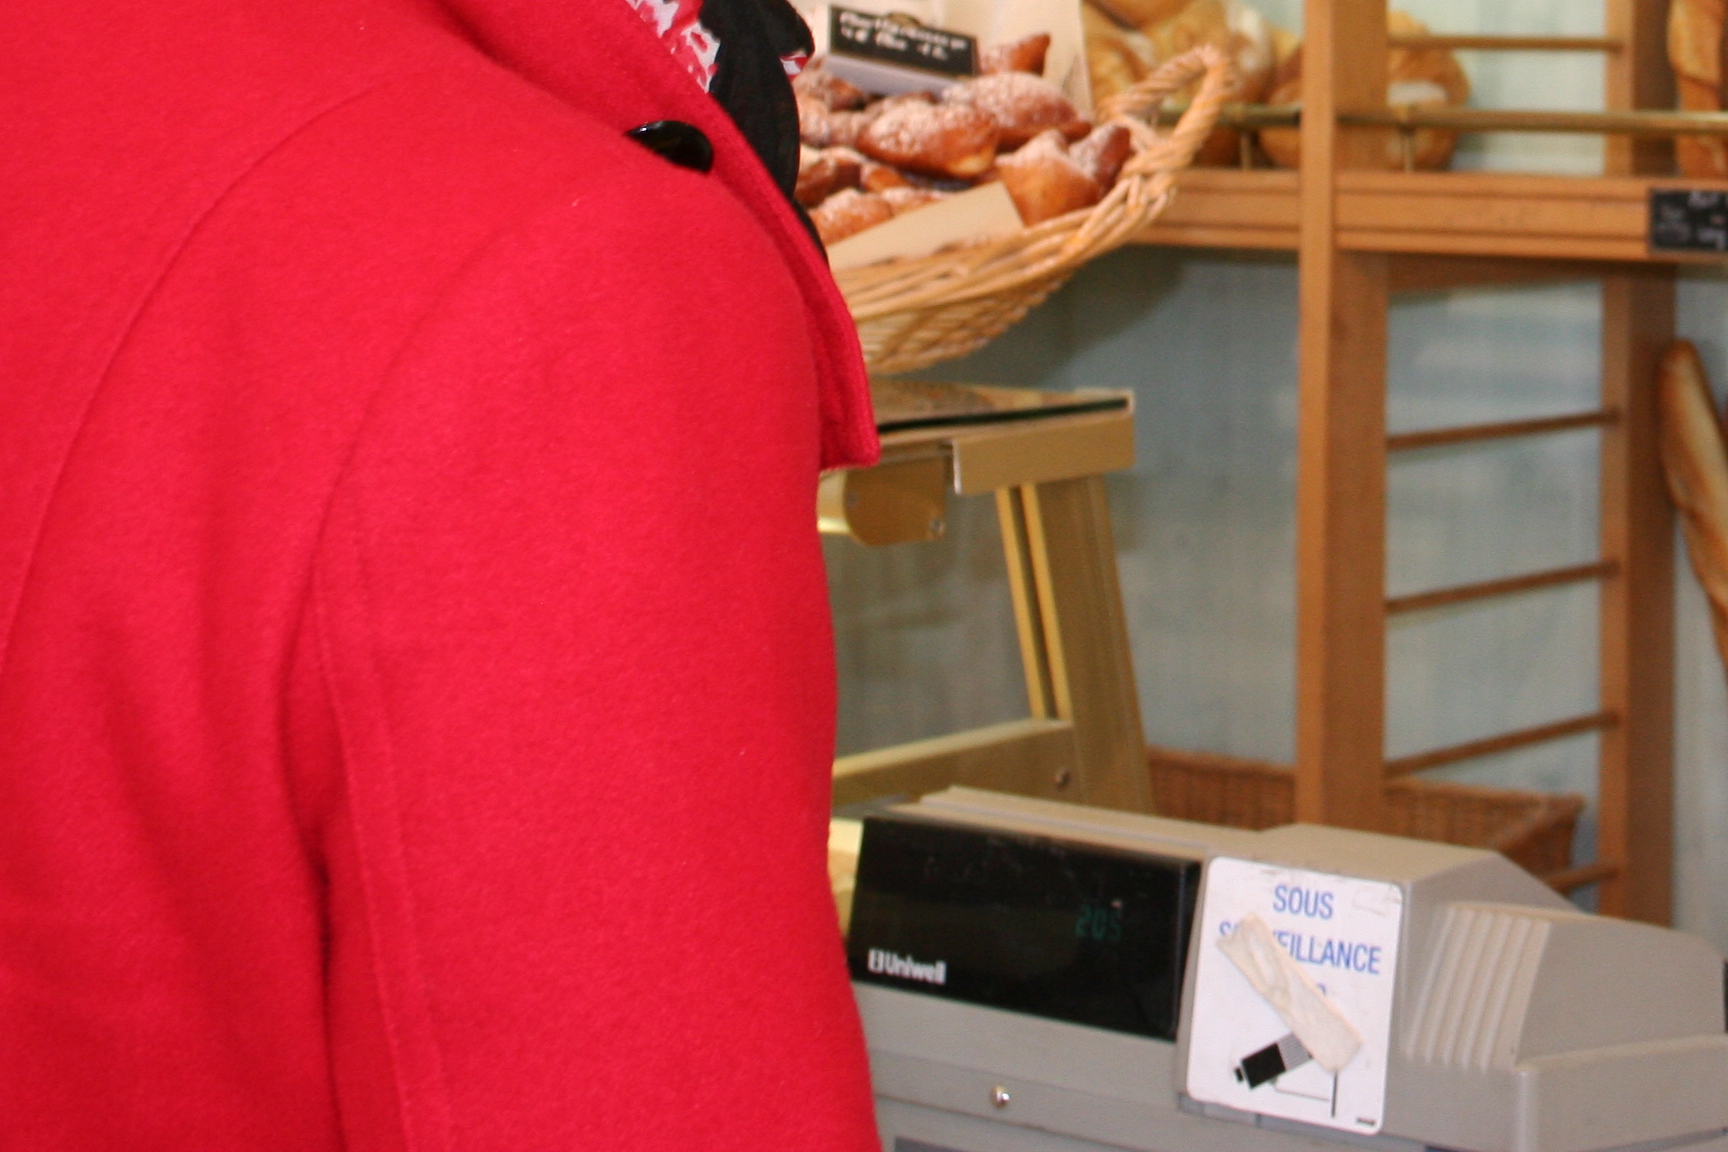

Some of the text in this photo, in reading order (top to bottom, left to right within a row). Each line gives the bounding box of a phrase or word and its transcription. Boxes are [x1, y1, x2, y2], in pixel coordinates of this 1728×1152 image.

[1273, 883, 1334, 920] SOUS
[1219, 921, 1382, 975] SEILLANCE
[884, 952, 947, 985] Uniwell
